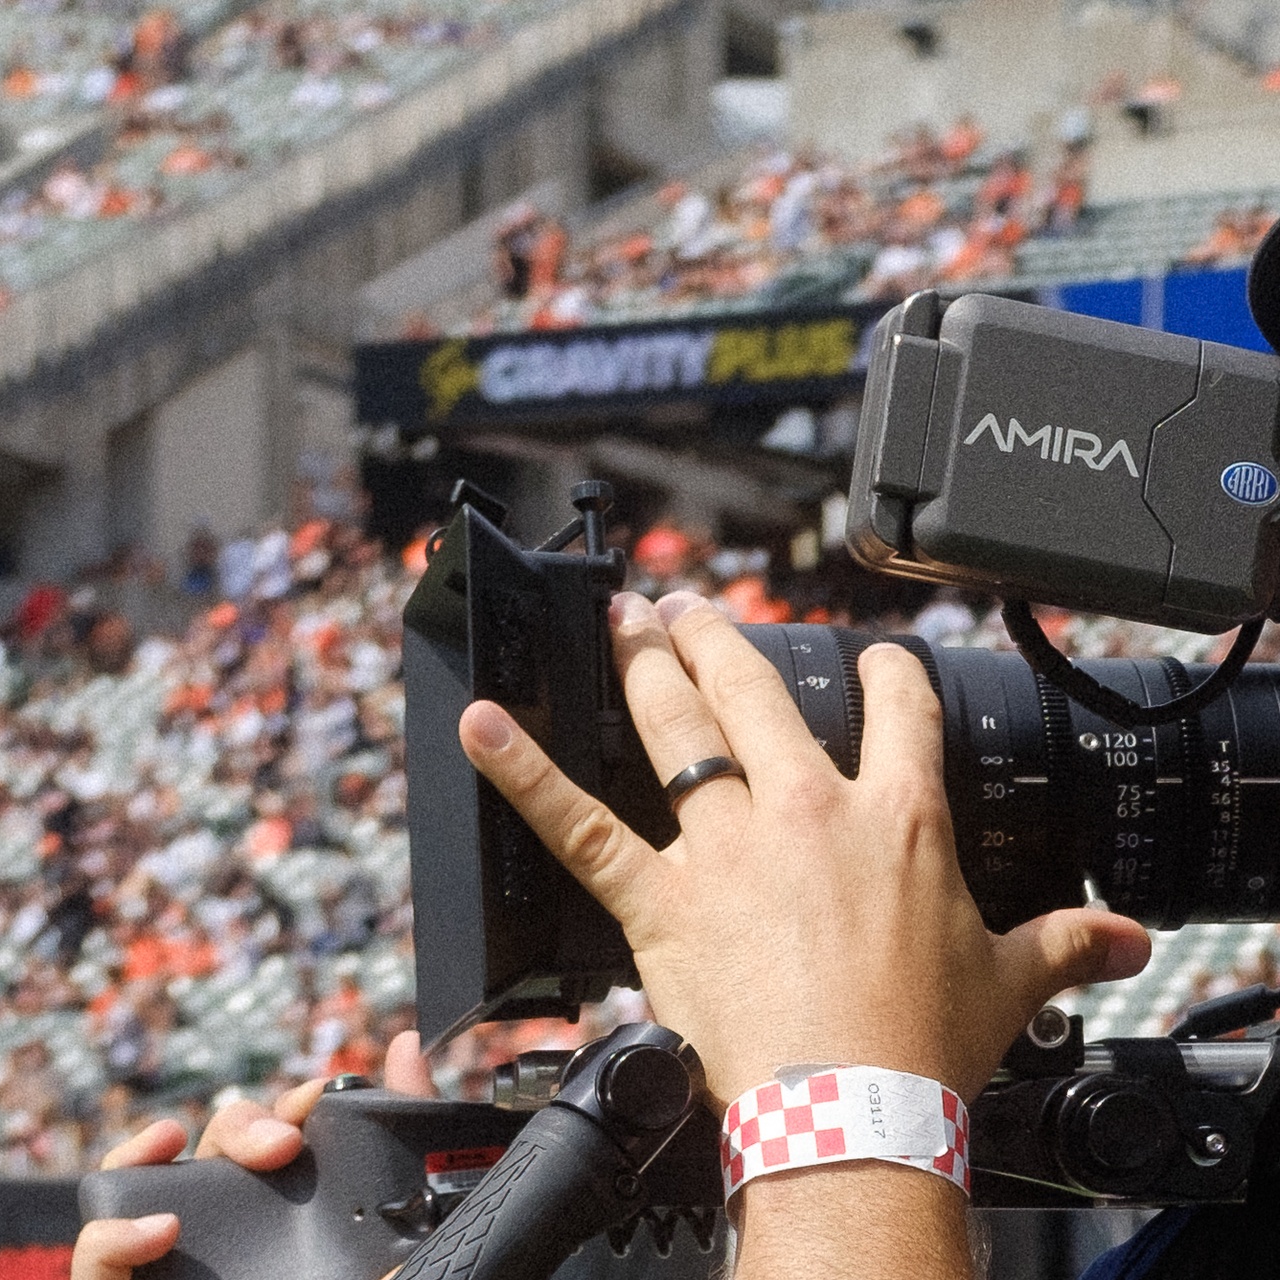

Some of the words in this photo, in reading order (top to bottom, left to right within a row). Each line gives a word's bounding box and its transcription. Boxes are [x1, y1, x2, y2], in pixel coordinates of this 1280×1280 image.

[964, 412, 1139, 479] AMIRA
[1227, 466, 1270, 501] ARRI
[982, 715, 997, 730] ft
[1103, 733, 1137, 749] 120
[1220, 740, 1230, 753] T
[1105, 752, 1138, 767] 100
[1221, 775, 1231, 786] 4
[983, 783, 1006, 800] 50
[1117, 785, 1141, 801] 75
[1117, 802, 1141, 818] 65
[1221, 812, 1231, 823] 8
[982, 832, 1005, 847] 20
[1116, 833, 1139, 849] 50
[868, 1083, 886, 1139] 03117
